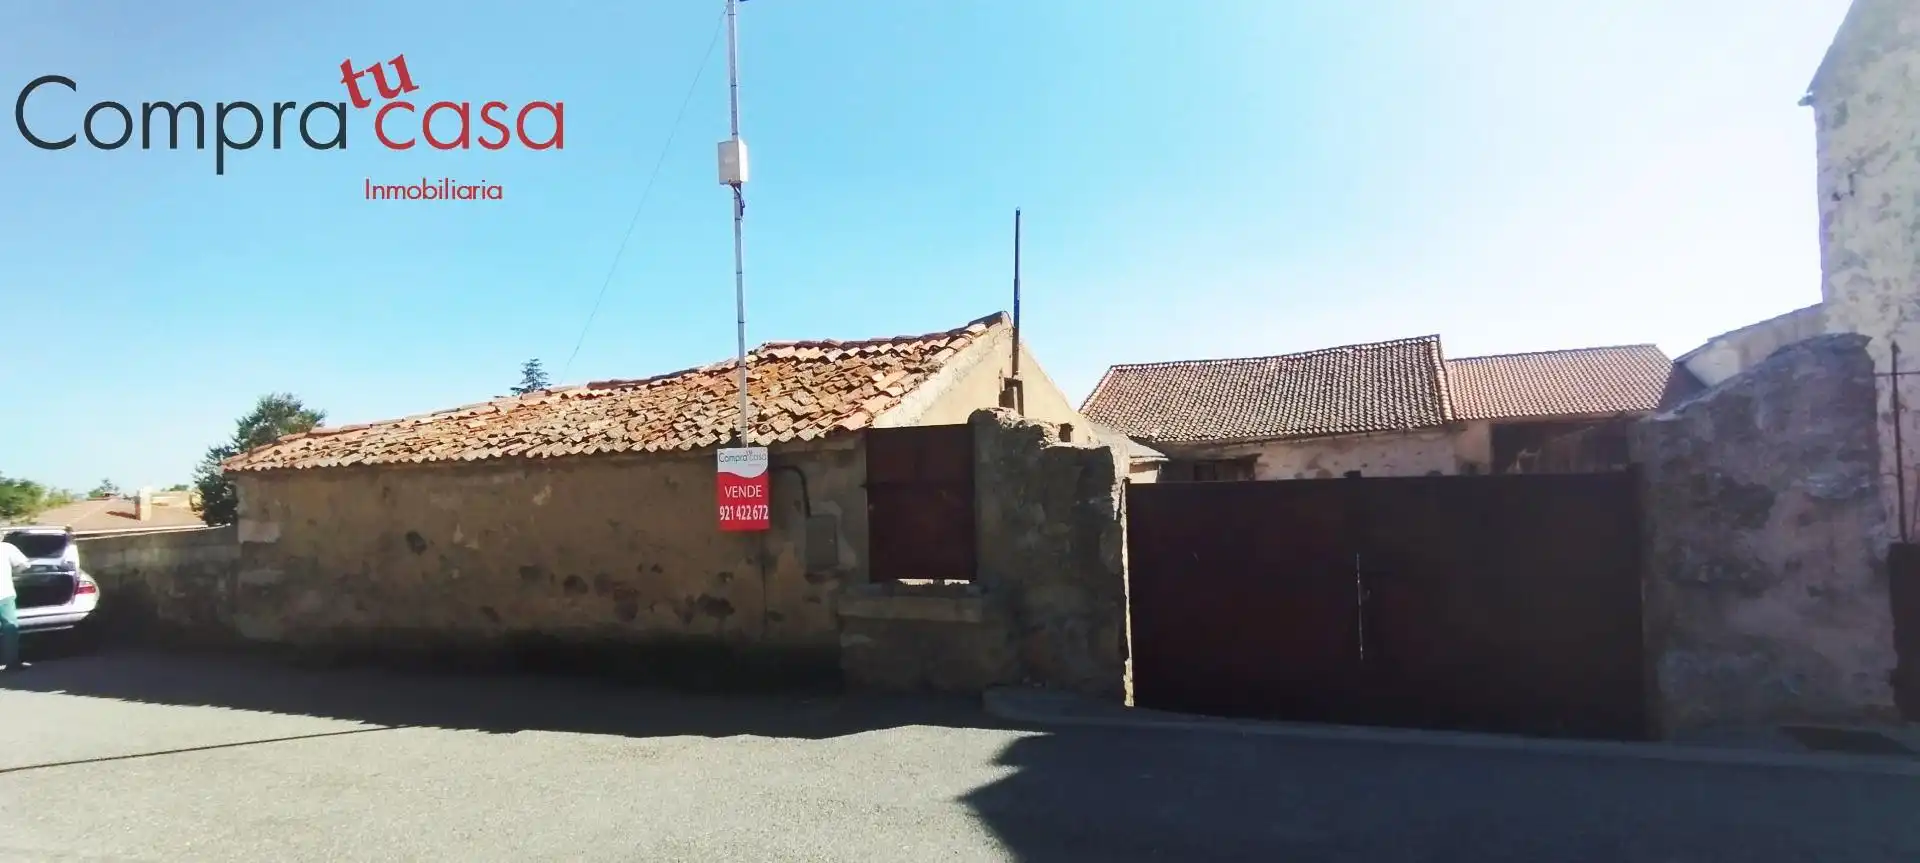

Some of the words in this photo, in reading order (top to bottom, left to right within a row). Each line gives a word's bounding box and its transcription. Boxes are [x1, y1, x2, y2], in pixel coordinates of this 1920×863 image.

[719, 452, 748, 464] Compra
[724, 484, 763, 498] VENDE
[719, 505, 735, 521] 921
[736, 504, 752, 521] 422
[752, 504, 769, 520] 672
